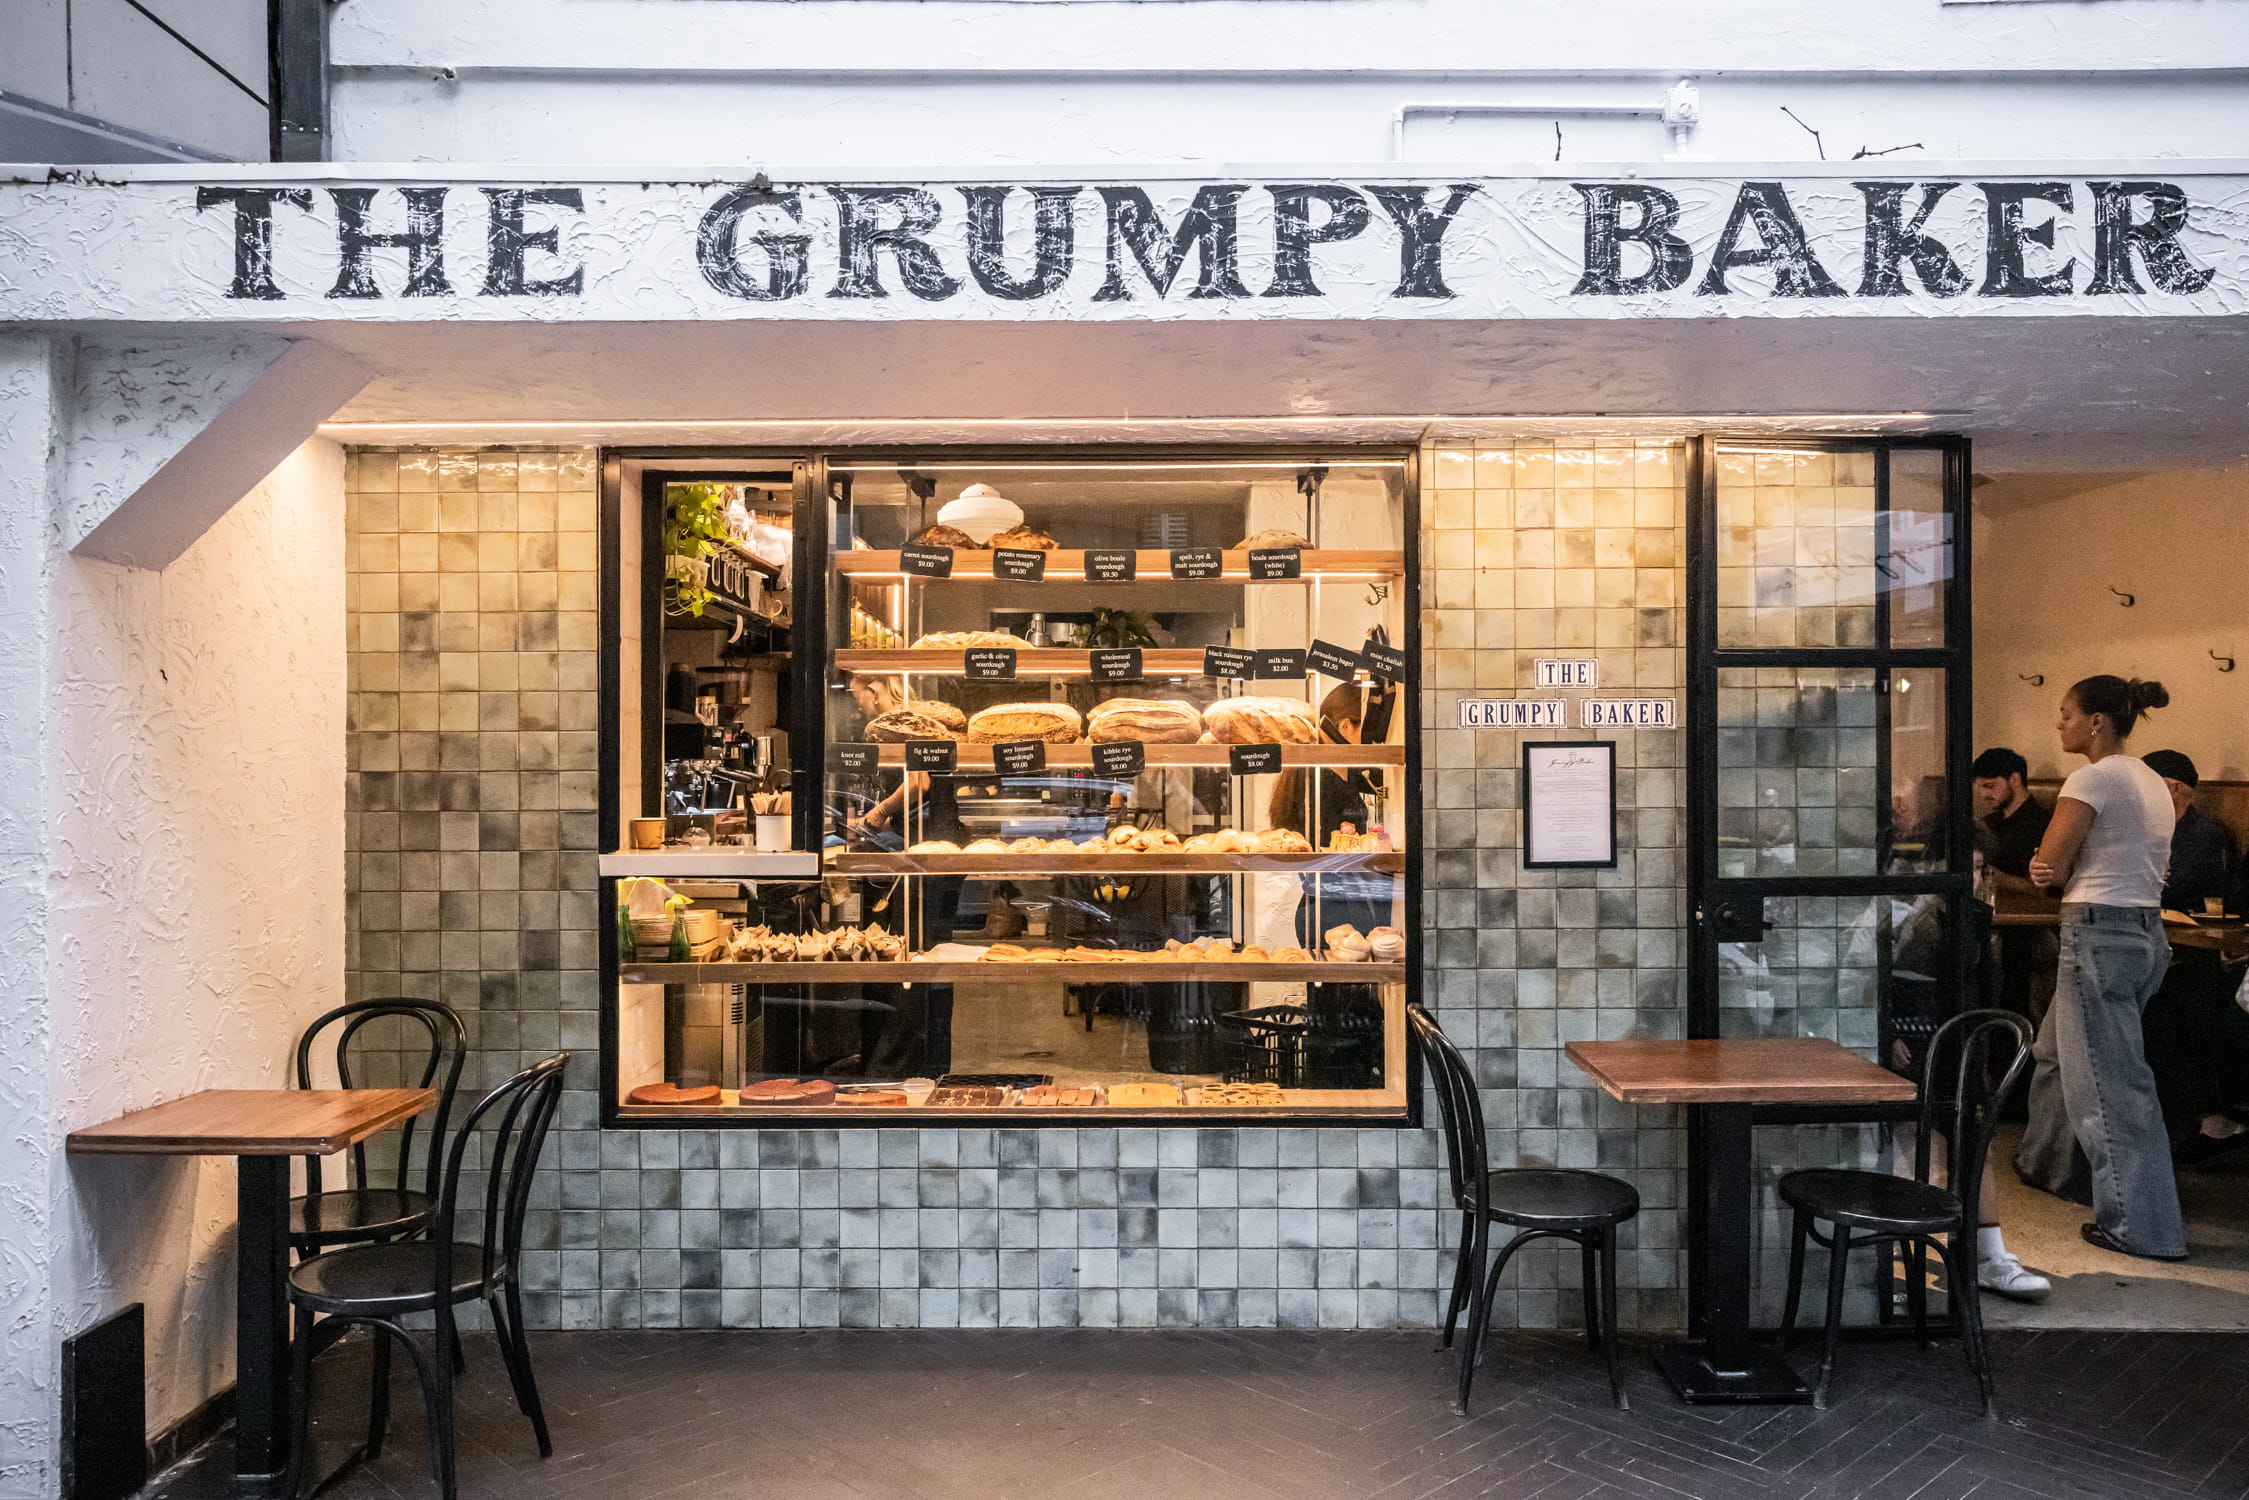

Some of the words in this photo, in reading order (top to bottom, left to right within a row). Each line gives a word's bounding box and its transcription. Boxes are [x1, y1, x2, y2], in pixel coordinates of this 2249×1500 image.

[197, 186, 584, 300] THE
[696, 184, 1483, 300] GRUMPY
[1569, 181, 2216, 297] BAKER
[904, 551, 920, 559] carrot
[921, 553, 949, 562] sourdough
[1268, 554, 1297, 562] sourdough
[1004, 560, 1034, 568] sourdough
[1095, 563, 1125, 571] sourdough
[1188, 561, 1218, 569] sourdough
[971, 653, 987, 661] garlic
[1208, 650, 1222, 658] black
[1223, 652, 1243, 660] russian
[1312, 649, 1338, 662] jerusalem
[1338, 657, 1354, 668] bagel
[1370, 652, 1383, 660] mini
[1383, 655, 1403, 668] challah
[976, 661, 1005, 669] sourdough
[1101, 661, 1131, 669] sourdough
[1215, 660, 1244, 669] sourdough
[1322, 661, 1338, 671] $3.50
[1376, 662, 1392, 672] $3.50
[1545, 663, 1587, 684] THE
[1468, 703, 1558, 724] GRUMPY
[1592, 703, 1665, 724] BAKER
[1014, 745, 1034, 753] linseed
[1004, 753, 1034, 761] sourdough
[1103, 755, 1133, 763] sourdough
[1240, 752, 1270, 760] sourdough
[1012, 761, 1028, 769] $9.00
